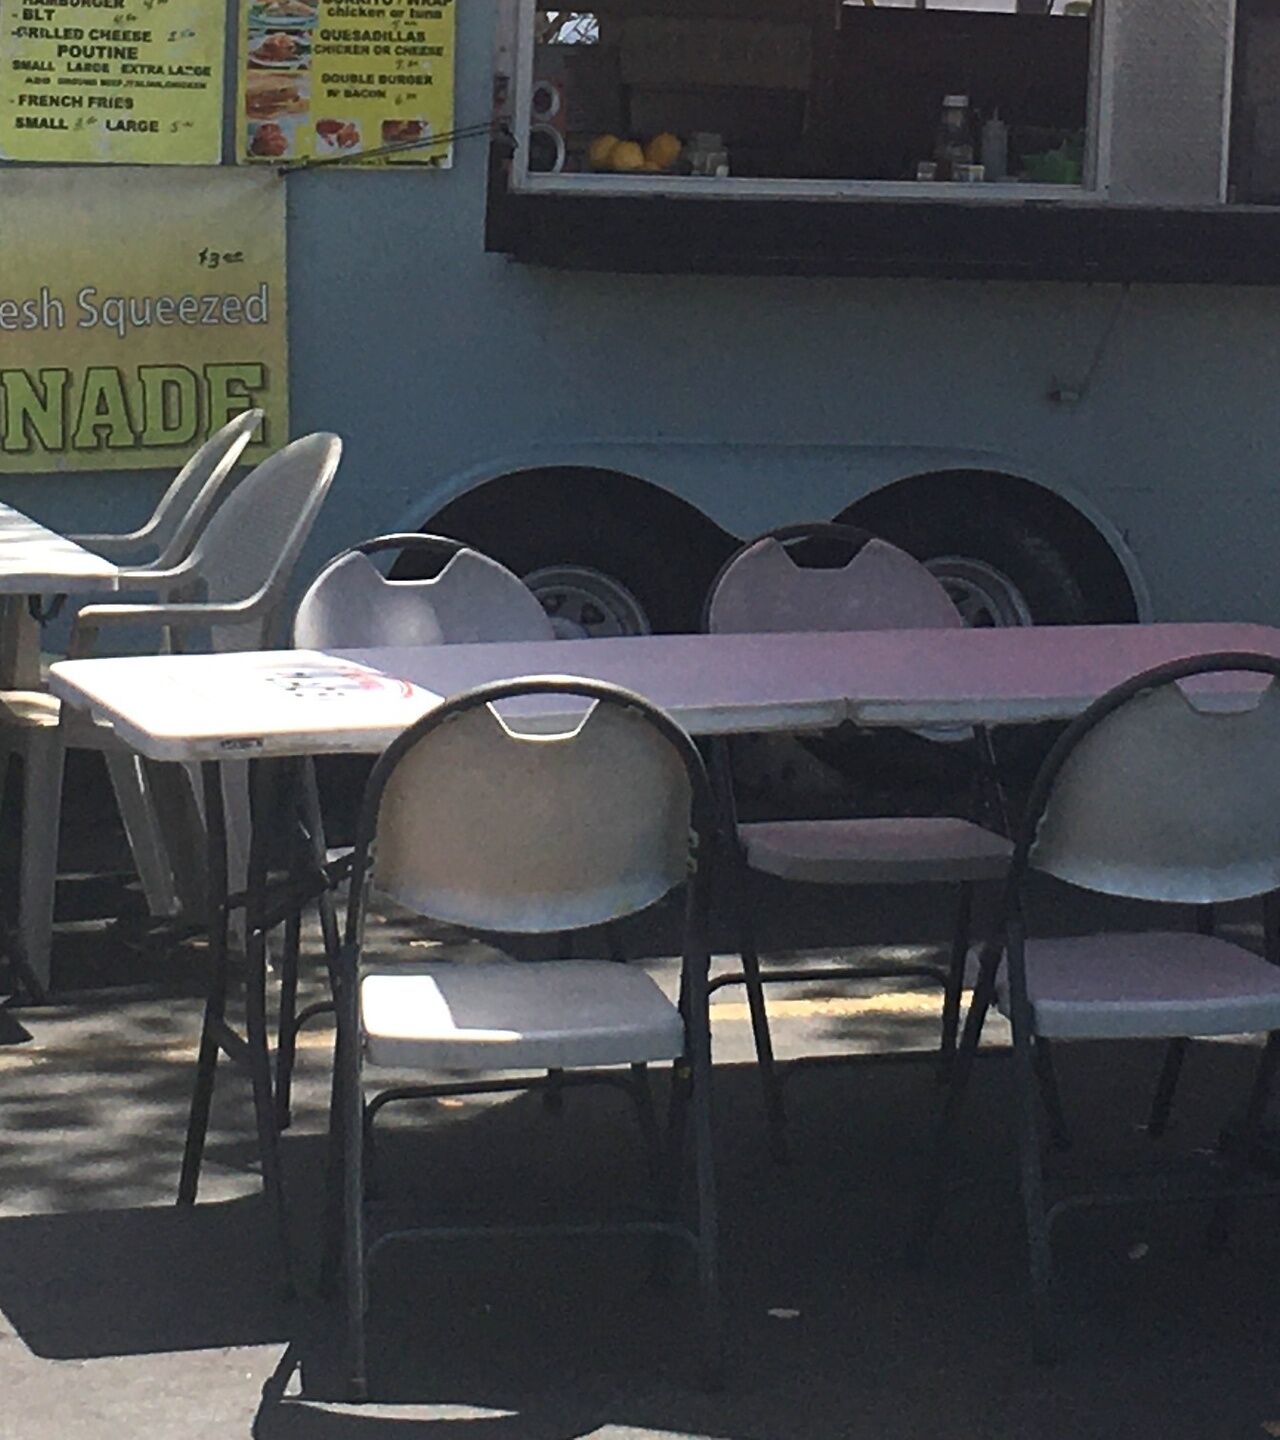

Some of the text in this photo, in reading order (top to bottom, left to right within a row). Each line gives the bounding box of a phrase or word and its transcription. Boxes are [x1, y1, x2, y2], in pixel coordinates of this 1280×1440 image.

[23, 9, 55, 21] BLT
[327, 6, 443, 19] chicken or tuna
[17, 26, 84, 40] GRILLED
[88, 29, 152, 42] CHEESE
[320, 29, 426, 42] QUESADILLAS
[57, 45, 138, 60] POUTINE
[314, 44, 444, 57] CHICKEN OR CHEESE
[12, 60, 55, 71] SMALL
[67, 62, 109, 73] LARGE
[121, 64, 164, 75] EXTRA
[321, 73, 433, 85] DOUBLE BURGER
[344, 89, 387, 99] BACON
[18, 95, 134, 109] FRENCH FRIES
[16, 117, 68, 130] SMALL
[106, 120, 159, 133] LARGE
[76, 281, 269, 338] Squeezed
